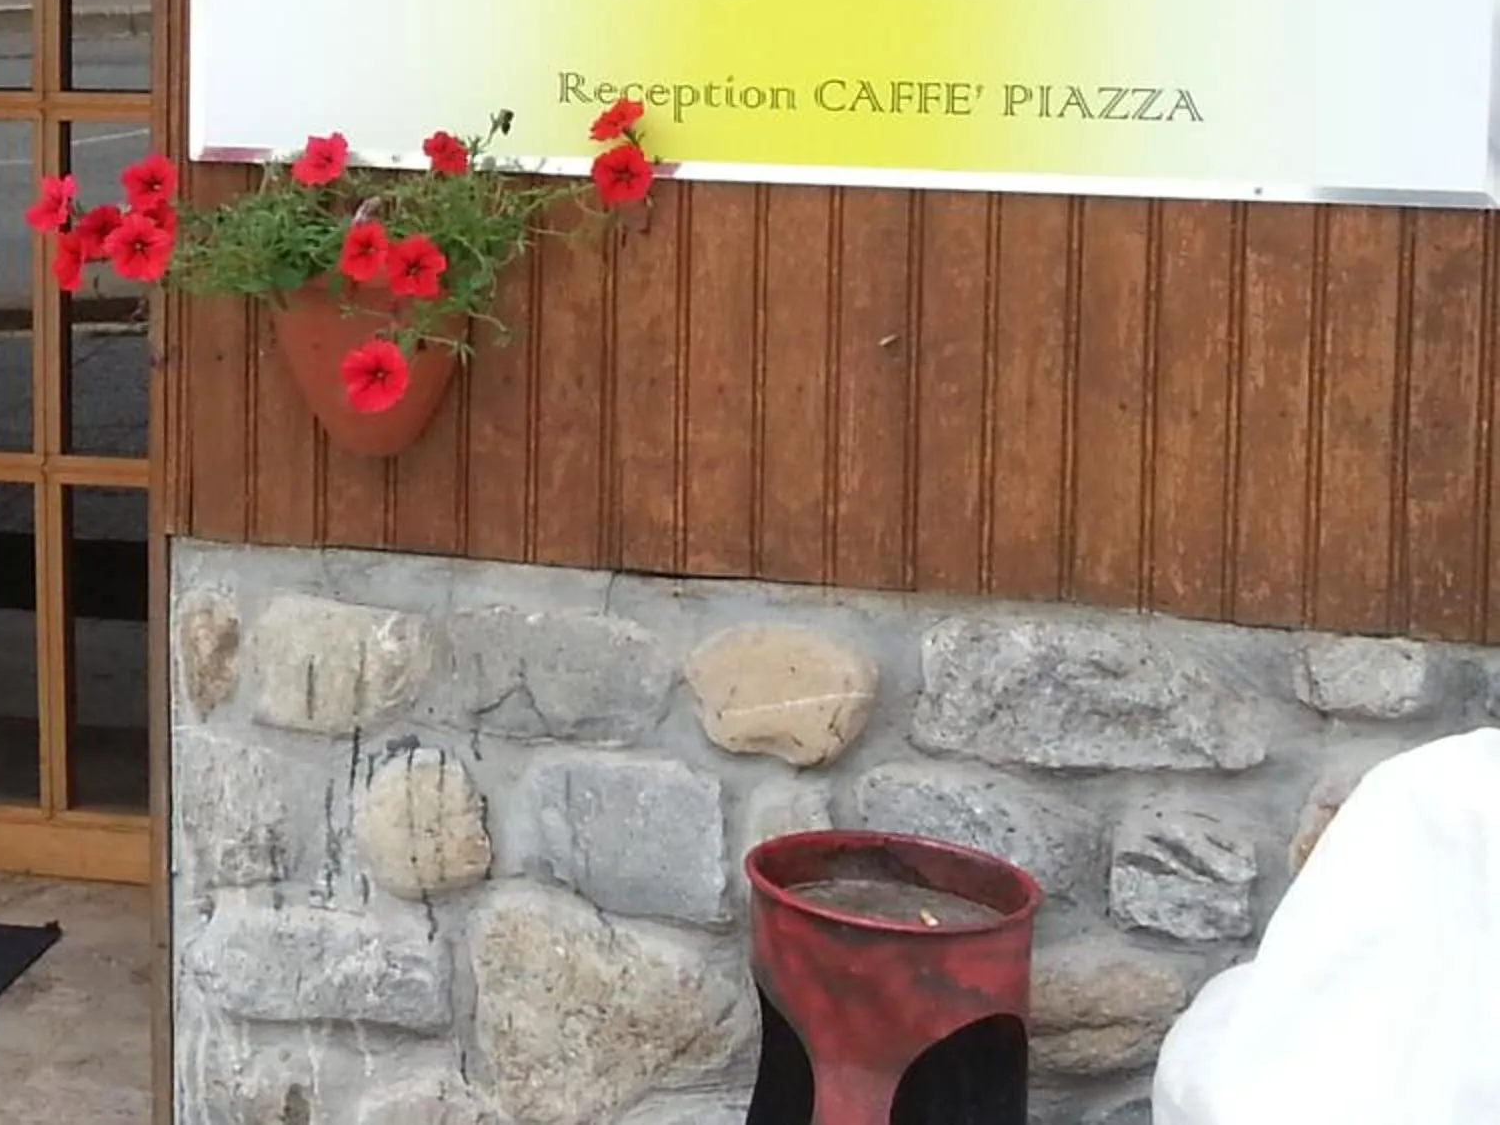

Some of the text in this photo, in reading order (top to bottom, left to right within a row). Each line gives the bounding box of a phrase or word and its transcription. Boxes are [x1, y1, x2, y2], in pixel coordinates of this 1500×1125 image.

[558, 71, 1205, 124] Reception CAFFE' PIAZZA
